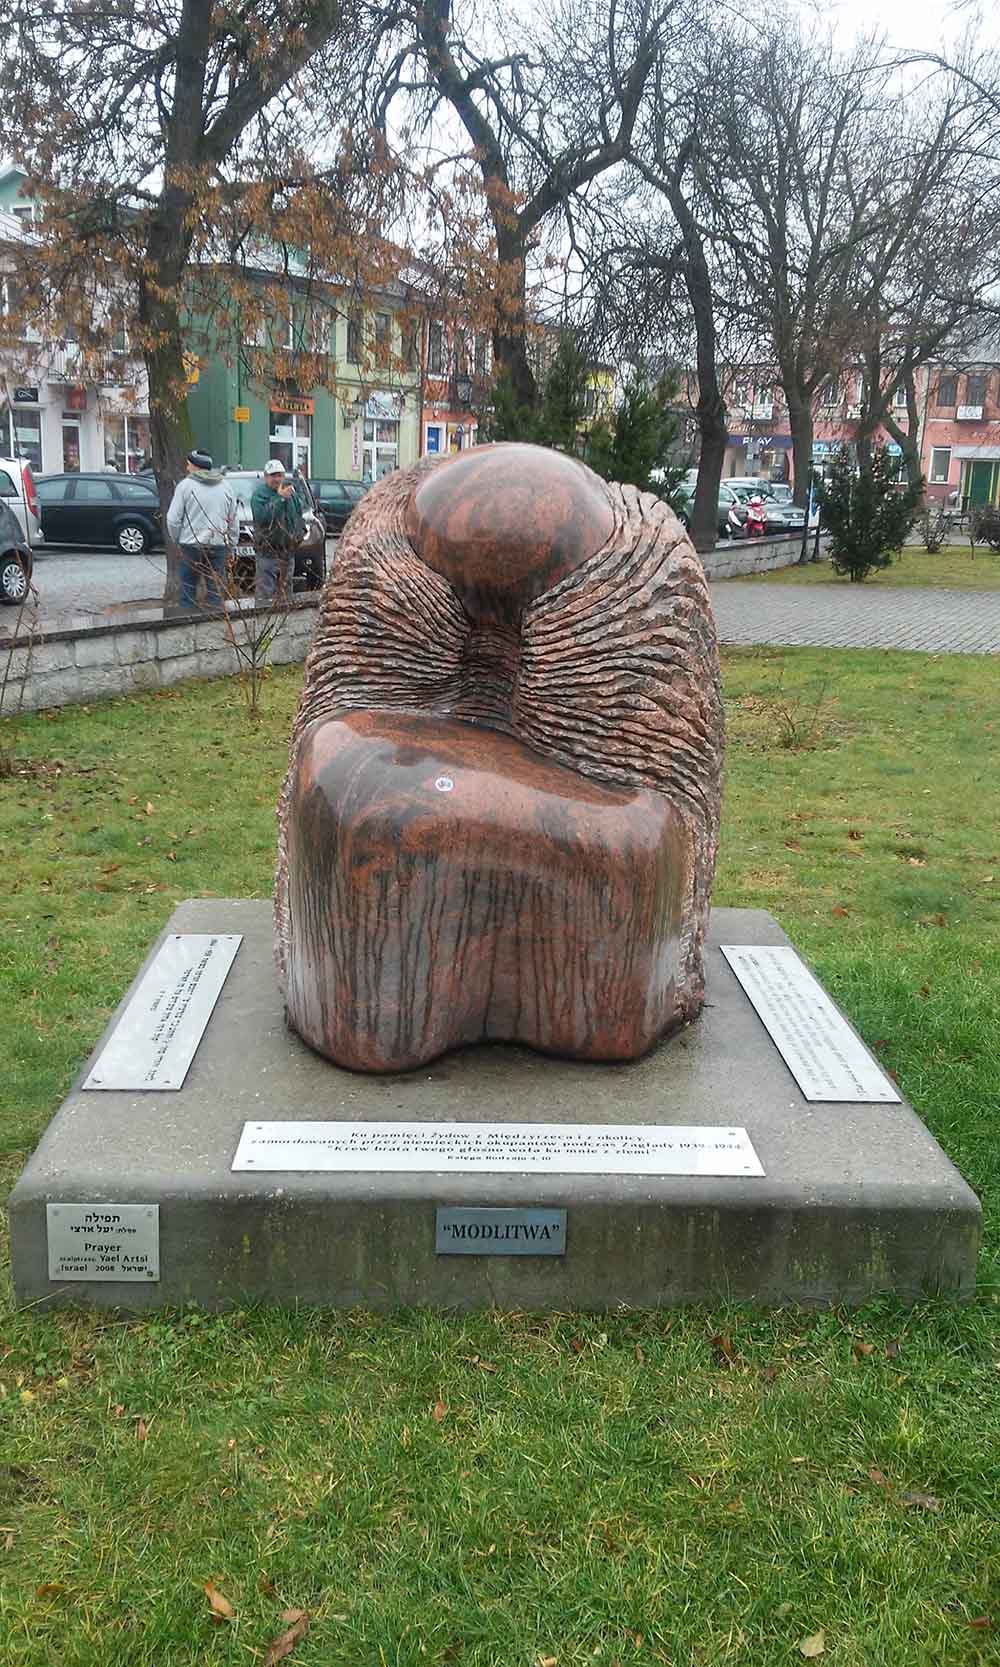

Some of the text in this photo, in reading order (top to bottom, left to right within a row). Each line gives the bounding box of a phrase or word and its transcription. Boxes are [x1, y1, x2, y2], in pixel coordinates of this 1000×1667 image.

[85, 1212, 121, 1223] תפילה
[70, 1225, 94, 1233] ארצי
[96, 1224, 114, 1233] יעל
[84, 1243, 121, 1253] Prayer
[60, 1264, 148, 1272] Israel 2008 ישראל
